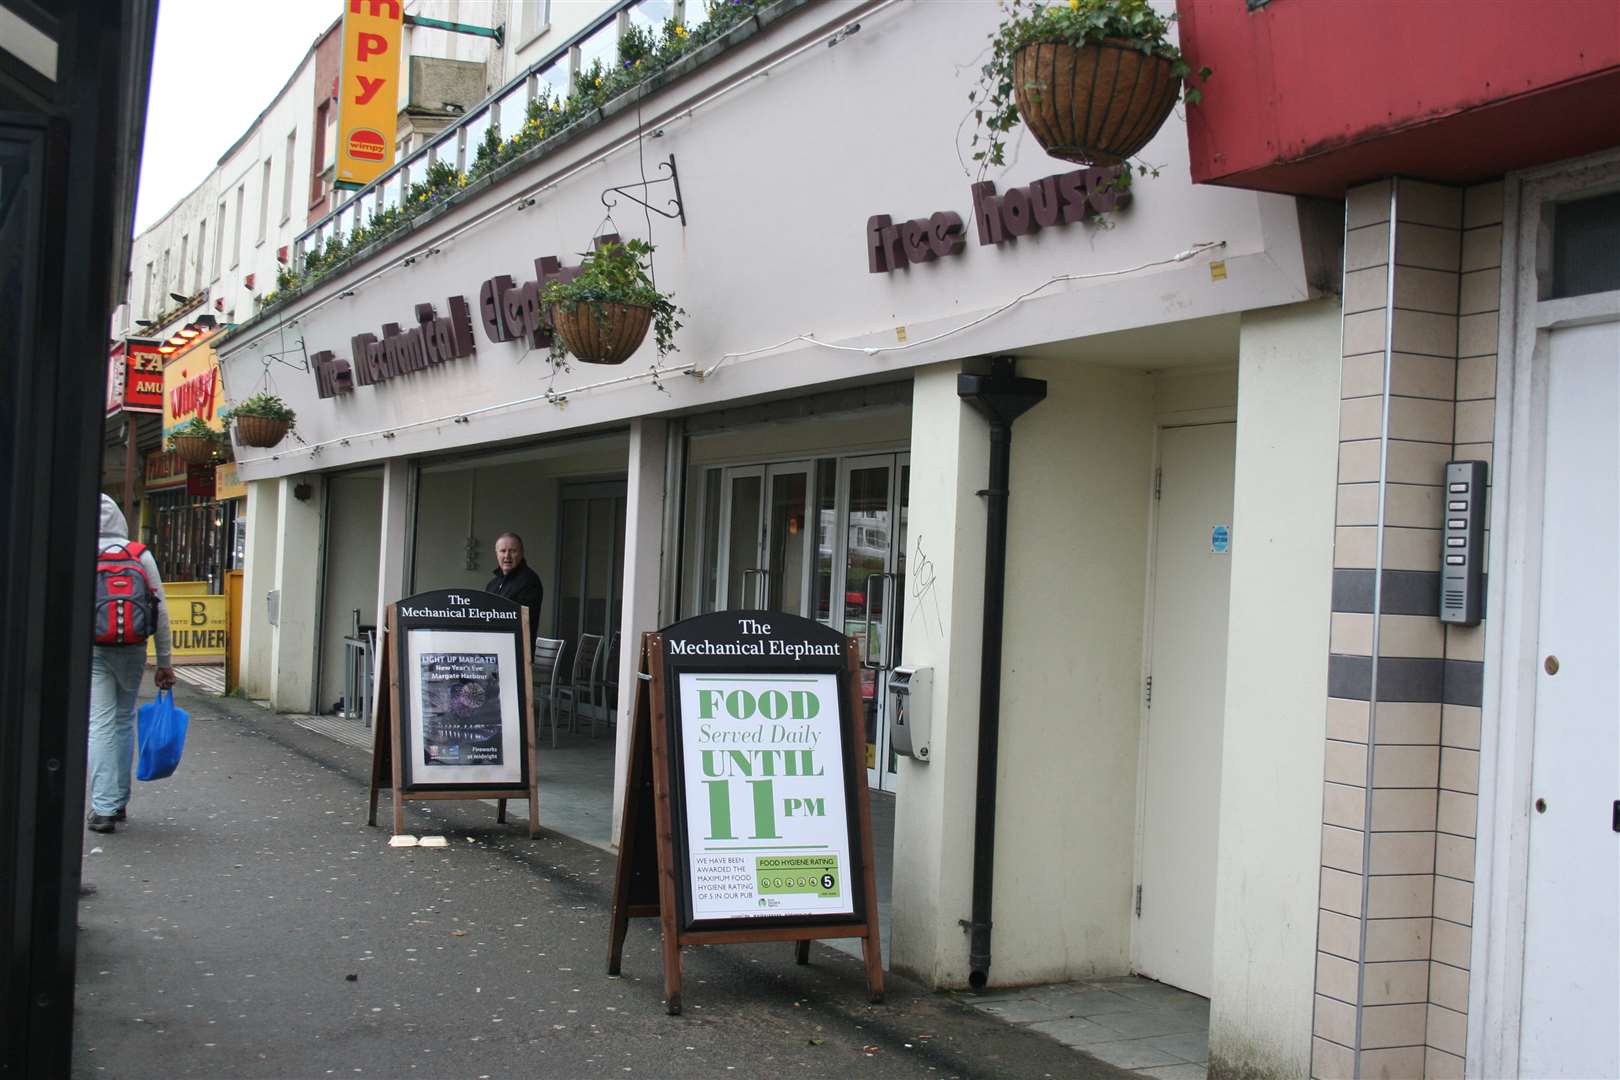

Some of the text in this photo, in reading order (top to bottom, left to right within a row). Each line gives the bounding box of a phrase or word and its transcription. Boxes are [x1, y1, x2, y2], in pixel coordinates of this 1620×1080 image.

[350, 142, 384, 153] wimpy
[867, 166, 1132, 273] free house
[351, 295, 476, 386] Mechanical
[448, 594, 470, 606] The
[191, 601, 208, 626] B
[401, 607, 518, 622] Mechanical Elephant
[738, 619, 771, 635] The
[669, 639, 840, 661] Mechanical Elephant
[422, 656, 445, 664] LIGHT
[696, 689, 820, 720] FOOD
[698, 724, 822, 750] Served Daily
[700, 749, 825, 777] UNTIL
[701, 779, 826, 840] 11 PM
[708, 857, 727, 865] HAVE
[727, 856, 745, 864] BEEN
[781, 858, 810, 866] HYGIENE
[823, 876, 832, 888] 5
